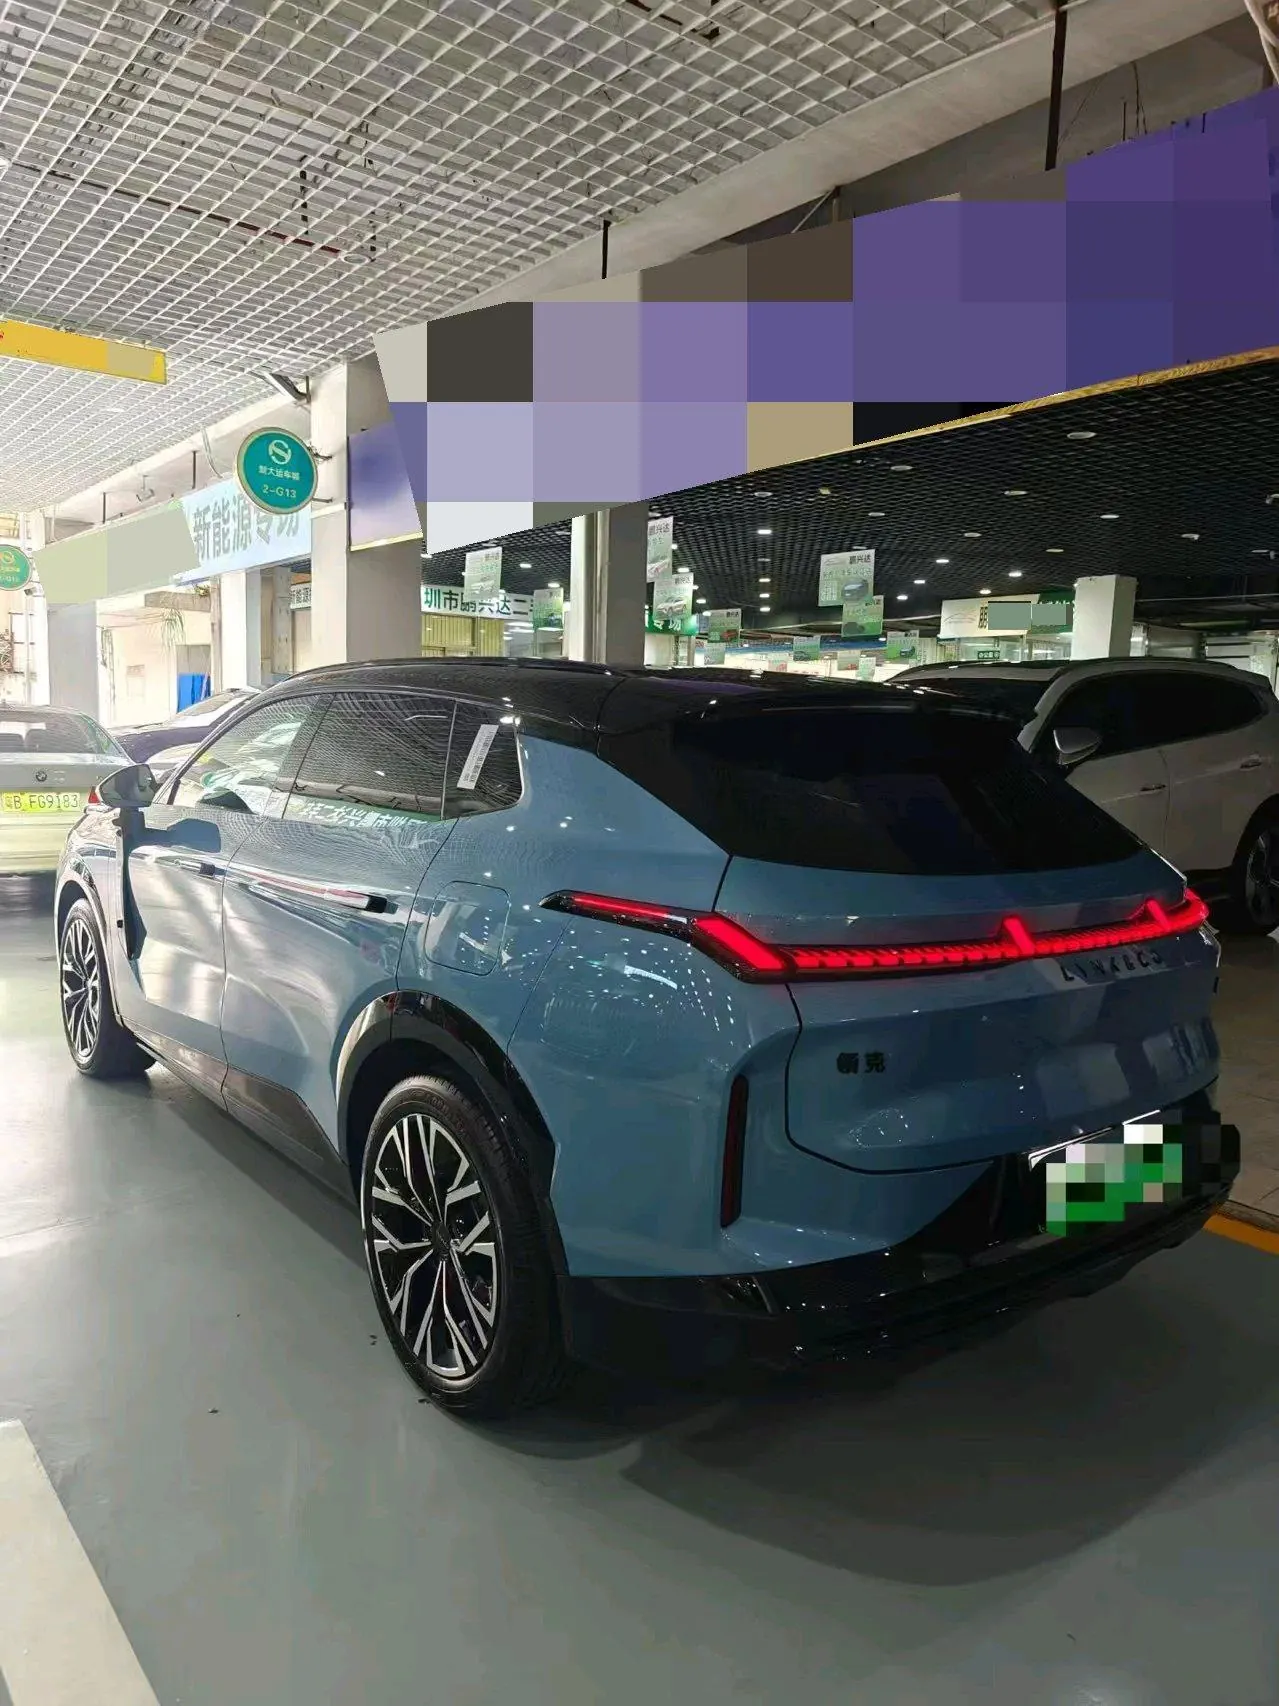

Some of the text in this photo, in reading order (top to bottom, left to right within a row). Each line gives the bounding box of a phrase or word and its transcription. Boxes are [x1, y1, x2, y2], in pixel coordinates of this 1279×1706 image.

[262, 484, 297, 498] 2-G13
[424, 588, 533, 616] 圳市鹏兴达二
